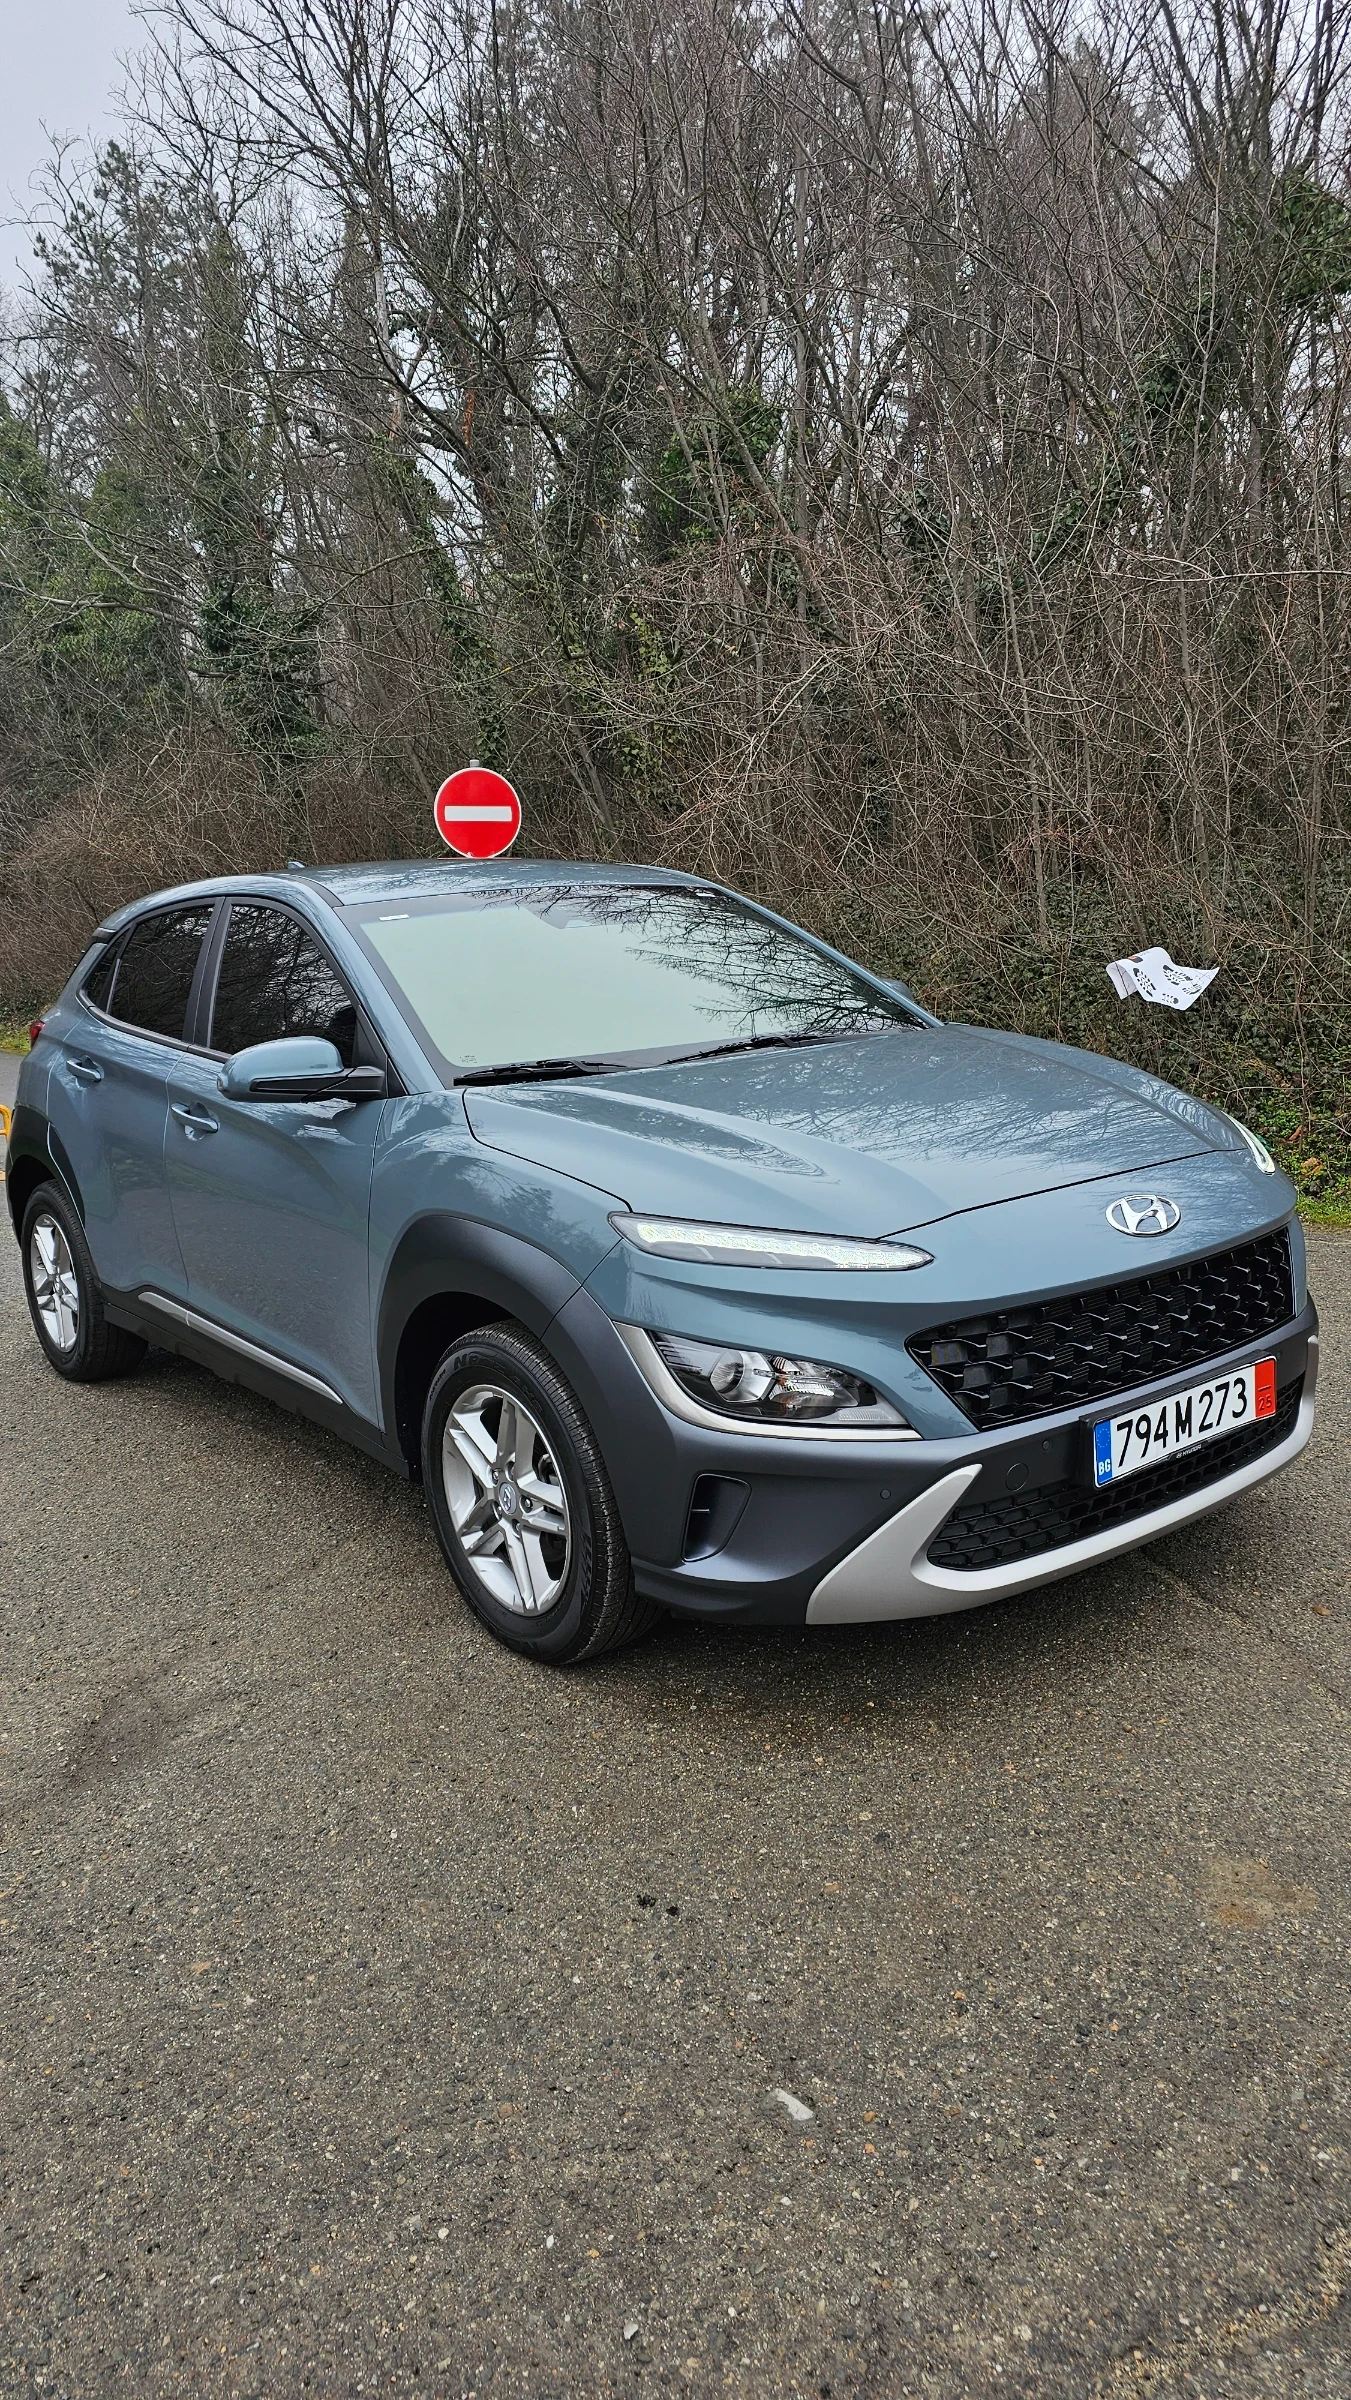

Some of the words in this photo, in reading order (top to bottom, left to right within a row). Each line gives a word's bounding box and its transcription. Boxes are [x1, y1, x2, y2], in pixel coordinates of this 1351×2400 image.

[1258, 1394, 1272, 1411] 25
[1116, 1377, 1247, 1467] 794M273
[1098, 1458, 1111, 1476] BG
